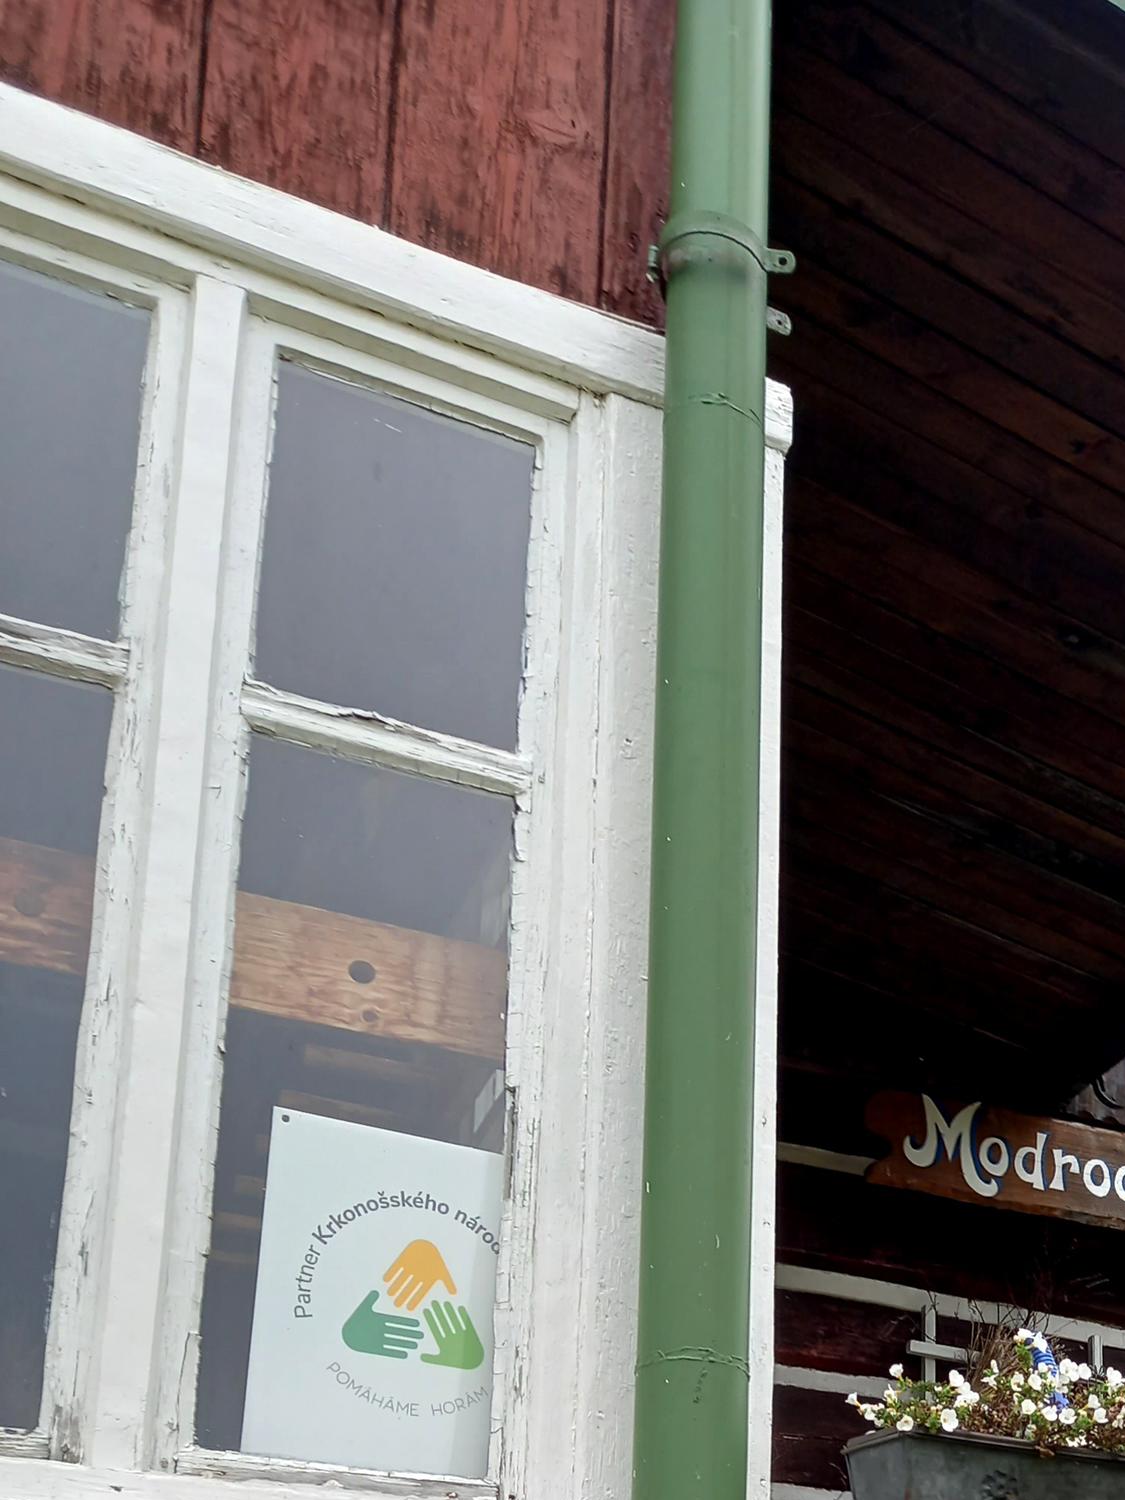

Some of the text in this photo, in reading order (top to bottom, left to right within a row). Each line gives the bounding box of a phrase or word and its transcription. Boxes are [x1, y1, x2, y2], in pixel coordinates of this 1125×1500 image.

[293, 1244, 321, 1319] Partner
[311, 1190, 449, 1245] Krkonošského
[325, 1361, 488, 1417] POMÁHÁME HORÁM
